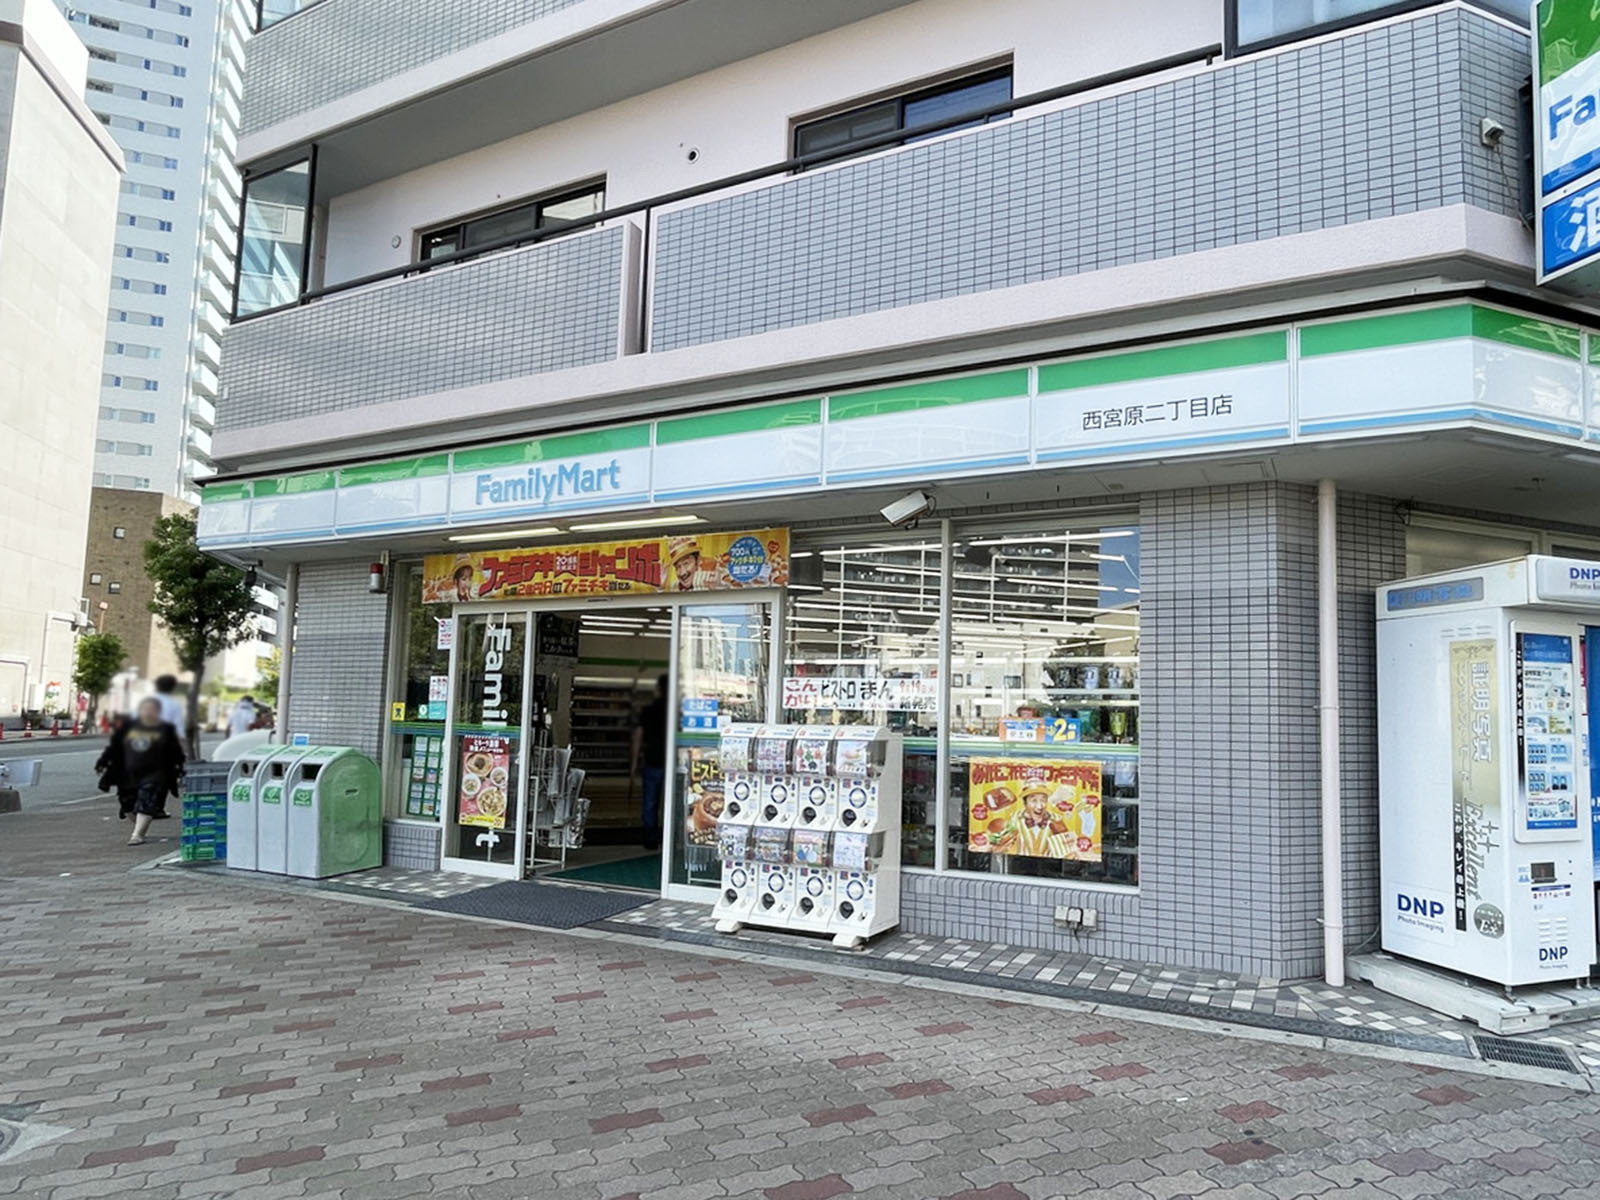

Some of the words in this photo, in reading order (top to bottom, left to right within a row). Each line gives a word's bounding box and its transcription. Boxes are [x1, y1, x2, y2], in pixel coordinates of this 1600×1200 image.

[1548, 89, 1600, 141] Fa
[1082, 394, 1233, 431] 西宮原二丁目店
[475, 458, 621, 506] FamilyMart
[1569, 567, 1600, 580] DNP
[1471, 661, 1492, 763] 証明写真
[1464, 798, 1484, 901] Excellent
[1397, 893, 1444, 918] DNP
[1539, 946, 1568, 961] DNP
